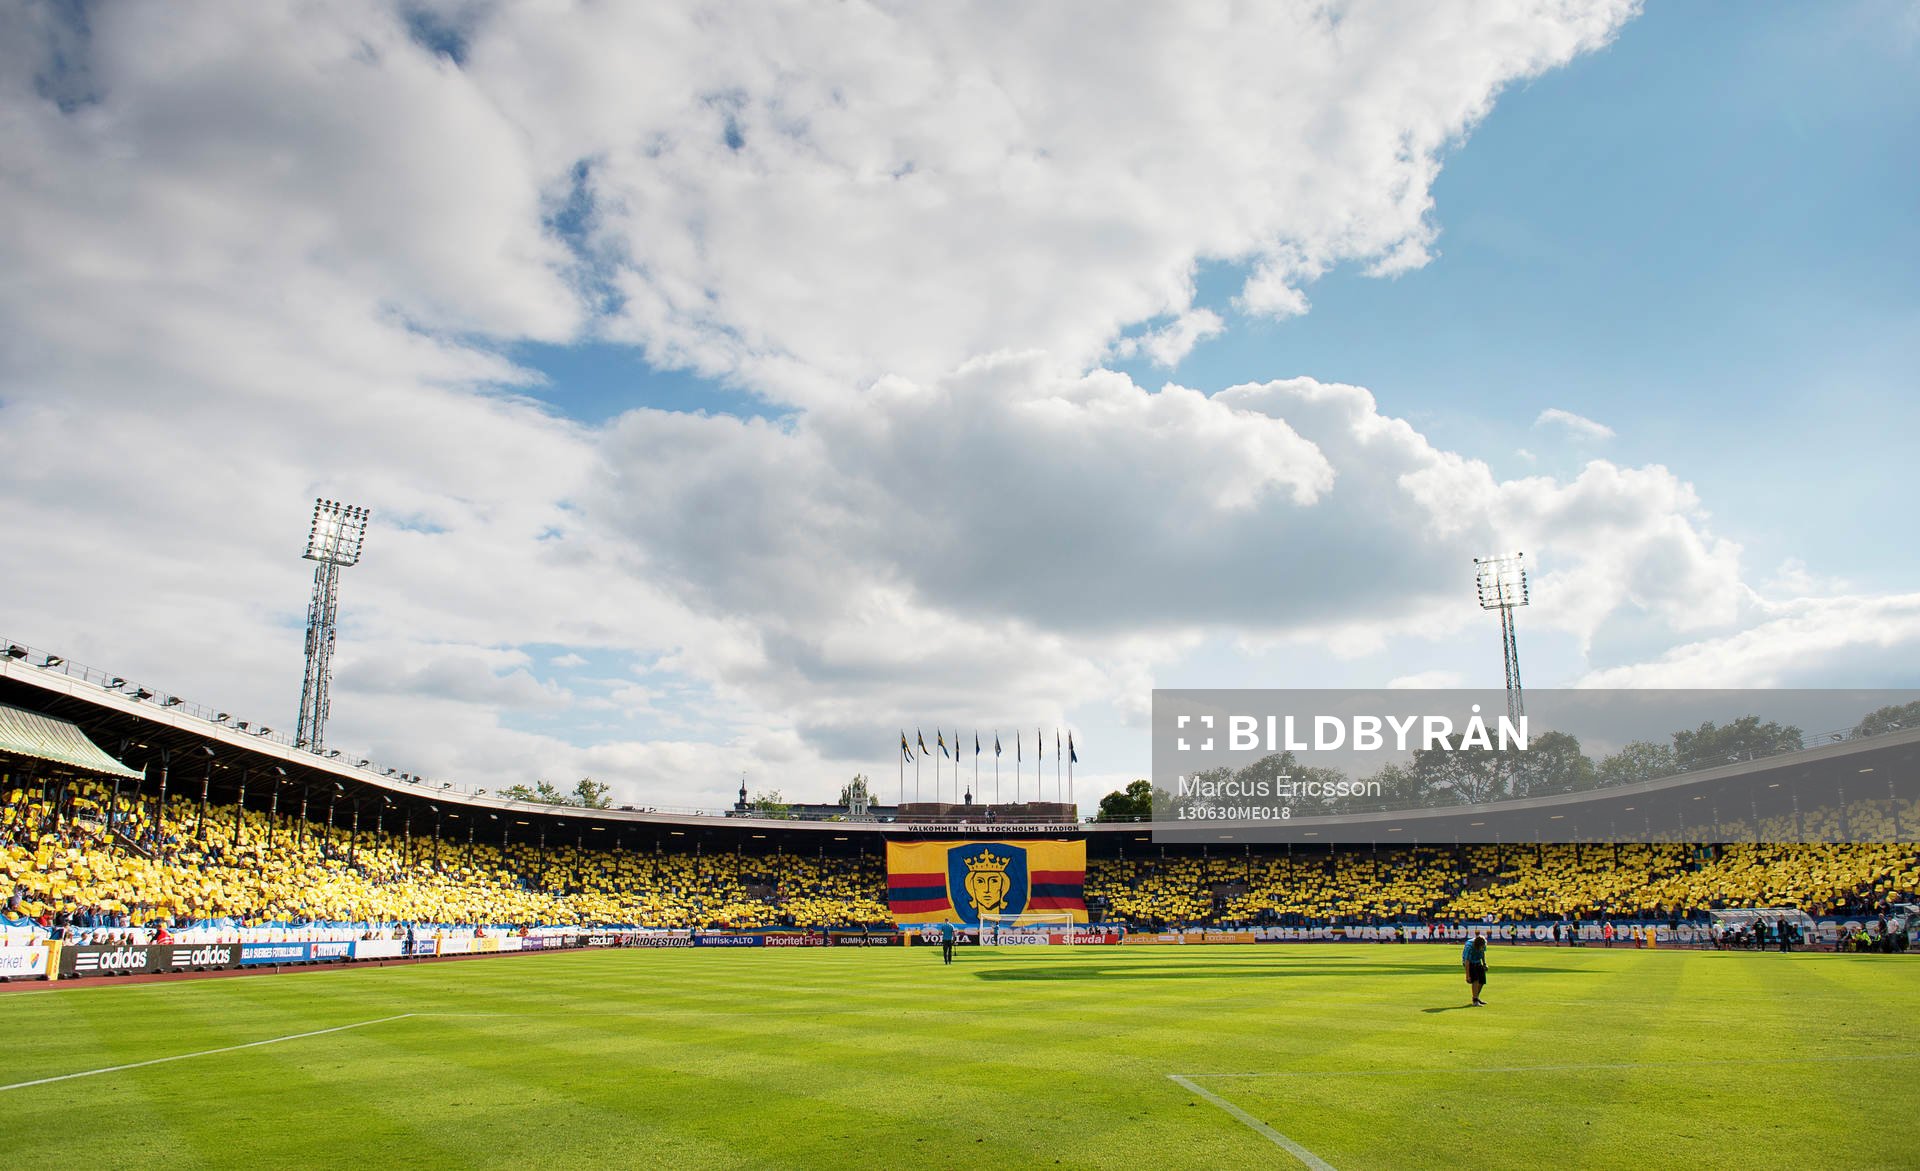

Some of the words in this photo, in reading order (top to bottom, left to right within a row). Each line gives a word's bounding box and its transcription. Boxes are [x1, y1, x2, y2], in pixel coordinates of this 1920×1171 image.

[908, 824, 959, 832] VÄLKOMMEN
[624, 935, 692, 947] BRIDGESTONE
[702, 936, 754, 945] Nilfisk-ALTO
[765, 935, 803, 946] Prioritet
[99, 947, 147, 969] adidas
[191, 946, 231, 965] adidas
